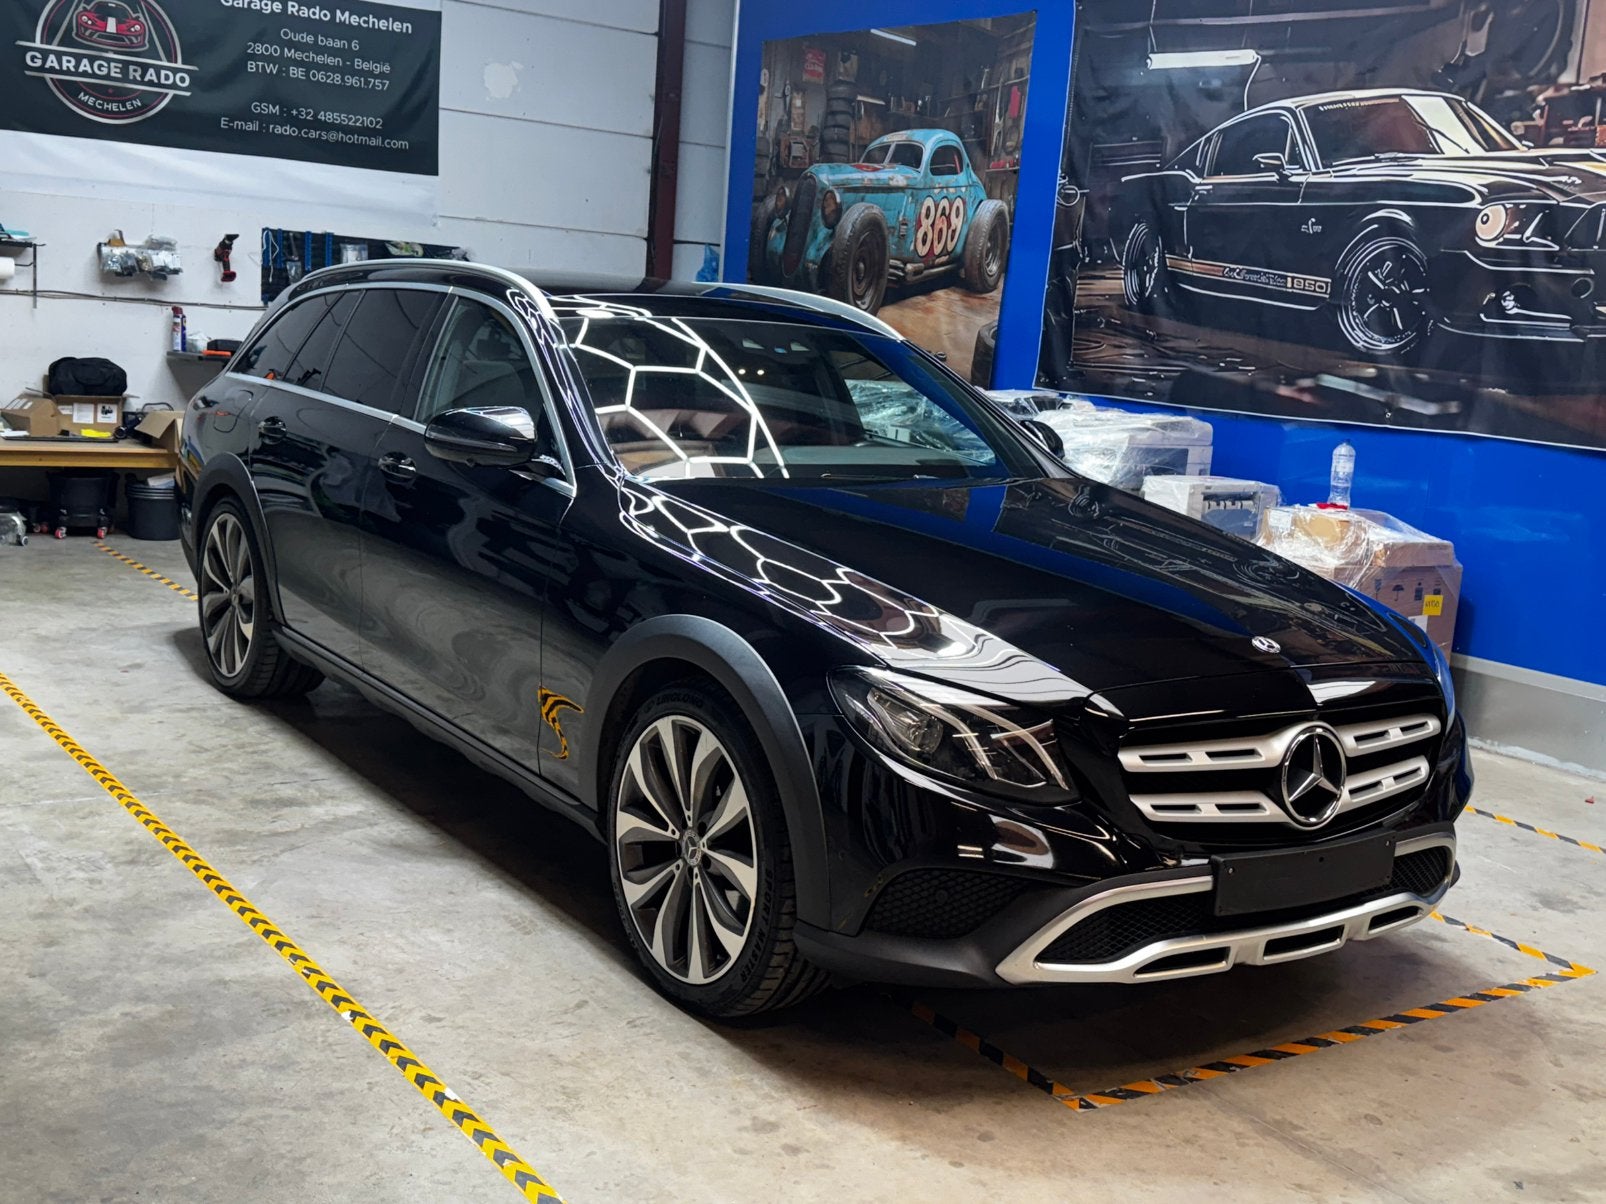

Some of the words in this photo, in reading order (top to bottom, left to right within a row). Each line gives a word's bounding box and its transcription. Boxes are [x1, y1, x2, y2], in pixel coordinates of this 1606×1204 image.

[287, 1, 331, 21] Rado
[336, 9, 412, 34] Mechelen
[280, 28, 315, 43] Oude
[318, 33, 348, 49] baan
[351, 40, 360, 51] 6
[25, 51, 123, 78] GARAGE
[128, 65, 190, 88] RADO
[247, 42, 280, 56] 2800
[284, 47, 343, 67] Mechelen
[354, 58, 391, 74] België
[247, 61, 279, 75] BTW
[289, 67, 306, 80] BE
[309, 69, 390, 91] 0628.961.757
[78, 91, 142, 112] MECHELEN
[251, 102, 280, 116] GSM
[290, 108, 314, 121] +32
[317, 111, 383, 130] 485522102
[220, 117, 260, 132] E-mail
[269, 122, 409, 150] rado.cars@hotmail.com
[914, 195, 964, 258] 869
[762, 868, 774, 926] SPORT
